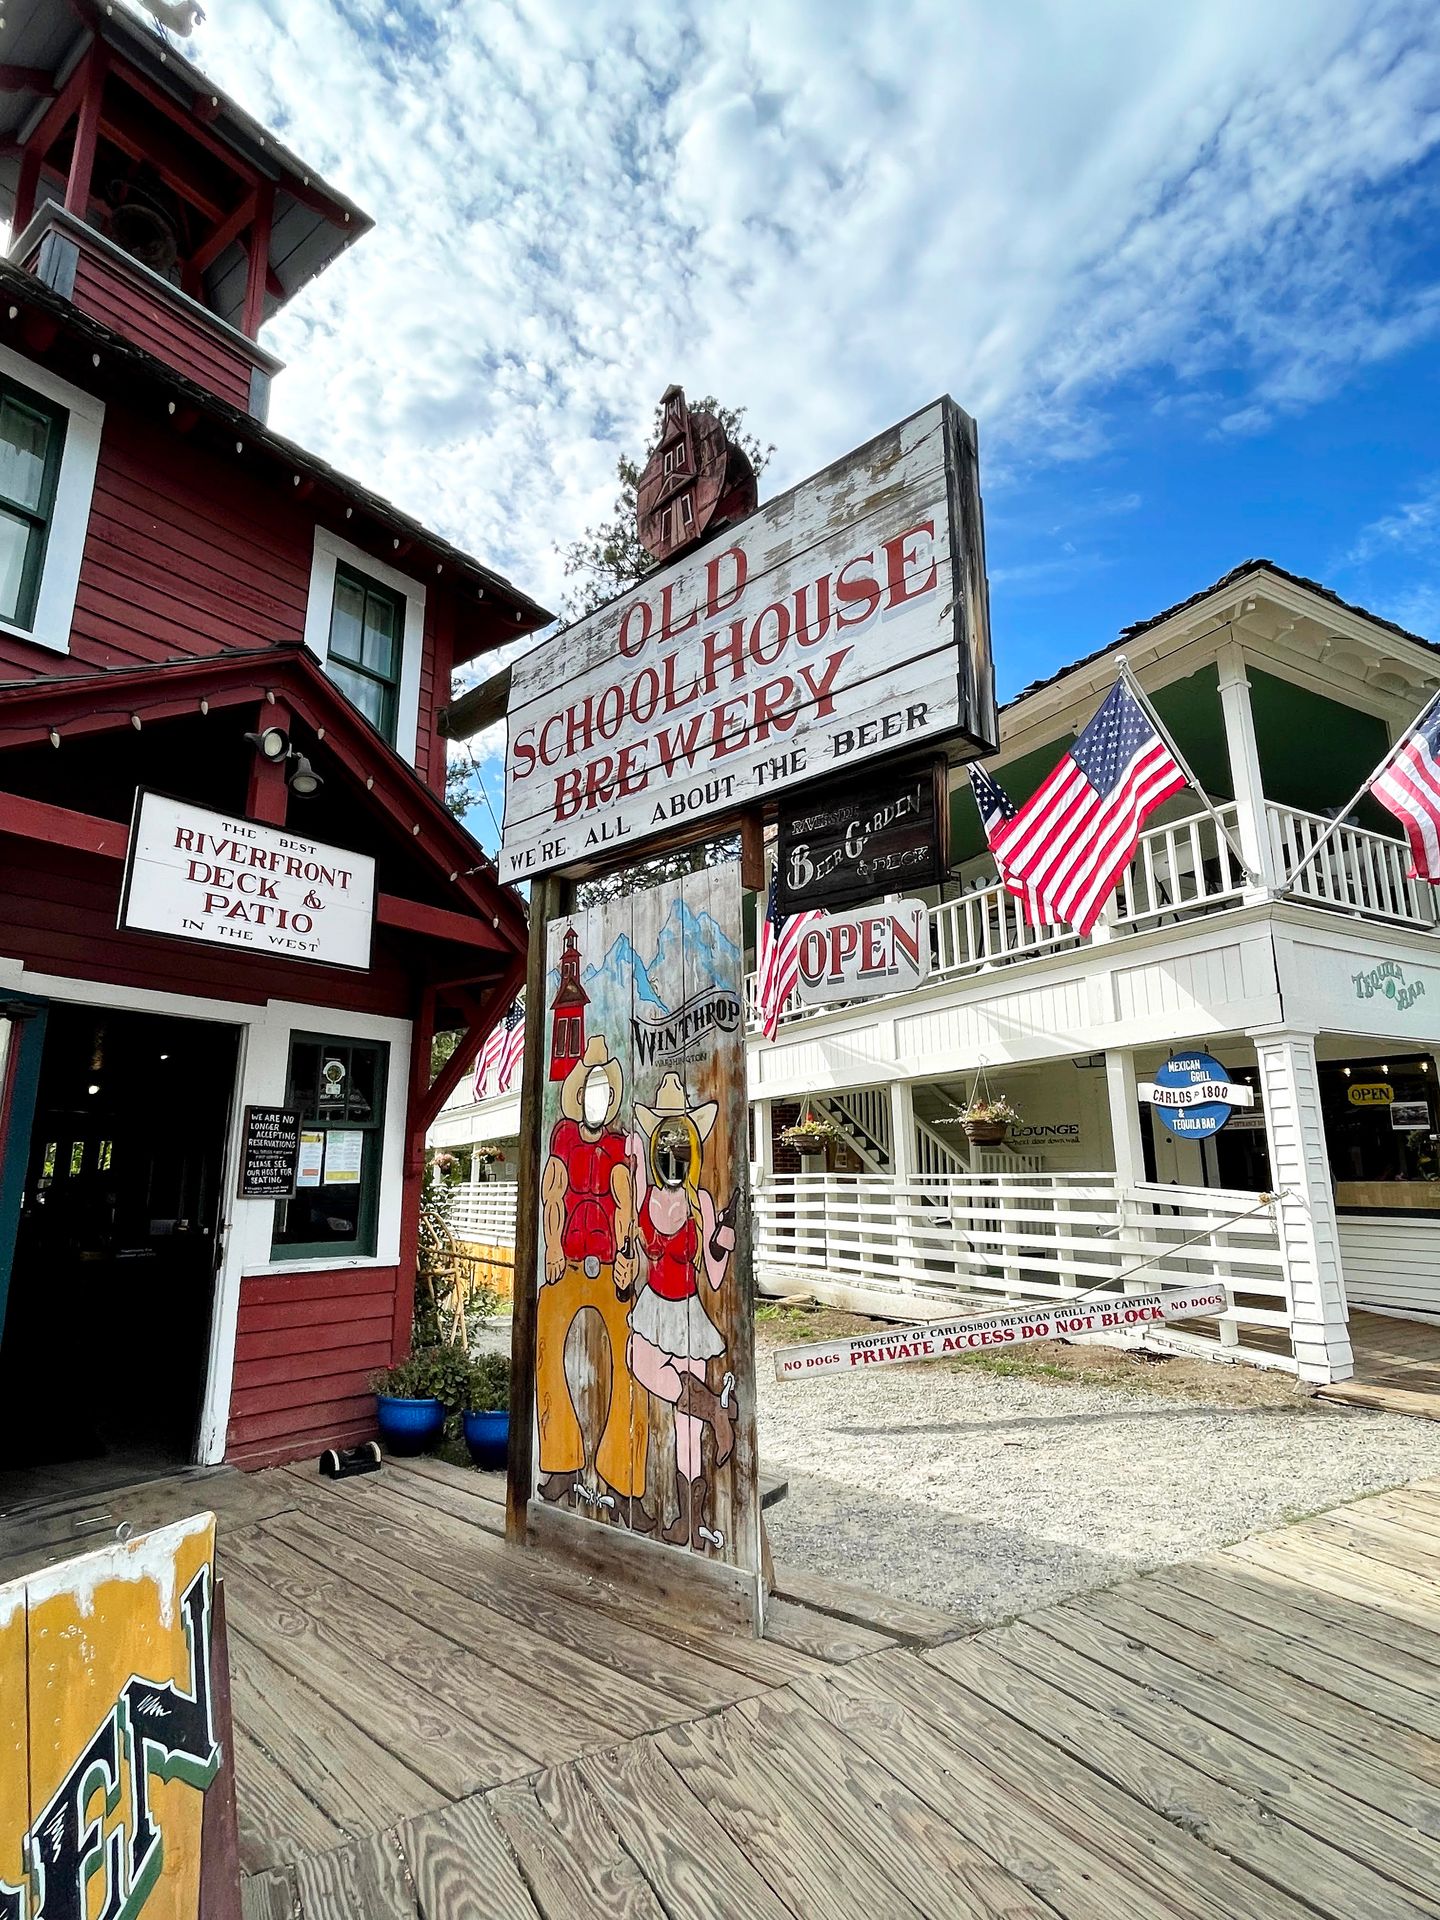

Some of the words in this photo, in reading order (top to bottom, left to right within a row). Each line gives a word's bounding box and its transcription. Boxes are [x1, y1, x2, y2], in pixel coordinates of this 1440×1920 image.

[619, 547, 748, 658] OLD
[513, 521, 938, 781] SCHOOLHOUSE
[554, 646, 855, 823] BREWERY
[510, 838, 567, 872] WE'RE
[585, 817, 631, 846] ALL
[651, 776, 735, 825] ABOUT
[753, 748, 807, 782] THE
[833, 703, 928, 758] BEER
[222, 822, 257, 839] THE
[279, 838, 317, 855] BEST
[787, 844, 844, 890] BEER
[845, 784, 921, 859] GARDEN
[174, 827, 352, 890] RIVERFRONT
[185, 859, 281, 901] DECK
[302, 889, 326, 910] &
[202, 892, 314, 934] PATIO
[182, 919, 205, 932] IN
[217, 925, 253, 941] THE
[268, 935, 319, 952] WEST
[799, 910, 922, 987] OPEN
[629, 999, 740, 1066] WINTHROP
[655, 1052, 707, 1068] WASHINGTON
[1168, 1059, 1200, 1072] MEXICAN
[1190, 1070, 1212, 1082] GRILL
[1153, 1089, 1192, 1104] CARLOS
[1202, 1086, 1228, 1098] 1800
[1352, 1087, 1393, 1101] OPEN
[264, 1114, 280, 1122] ARE
[282, 1116, 294, 1124] NO
[1178, 1108, 1184, 1118] &
[250, 1122, 280, 1131] LONGER
[1012, 1124, 1079, 1136] LOUNGE
[1172, 1118, 1200, 1130] TEQUILA
[1202, 1118, 1216, 1129] BAR
[248, 1138, 296, 1148] RESERVATIONS
[256, 1131, 296, 1140] ACCEPTING
[248, 1160, 272, 1168] PLEASE
[274, 1160, 288, 1168] SEE
[262, 1168, 278, 1176] HOST
[280, 1168, 292, 1176] FOR
[250, 1176, 282, 1184] SEATING
[1170, 1300, 1189, 1312] NO
[1192, 1294, 1223, 1308] DOGS
[850, 1333, 909, 1349] PROPERTY
[911, 1329, 928, 1340] OF
[1000, 1312, 1051, 1328] MEXICAN
[1054, 1306, 1086, 1320] GRILL
[1089, 1303, 1112, 1314] AND
[1114, 1296, 1162, 1311] CANTINA
[850, 1340, 935, 1366] PRIVATE
[942, 1328, 1015, 1350] ACCESS
[1021, 1322, 1050, 1340] DO
[1056, 1316, 1094, 1335] NOT
[1101, 1305, 1164, 1326] BLOCK
[783, 1360, 802, 1372] NO
[806, 1353, 840, 1368] DOGS
[0, 1563, 221, 1920] EN
